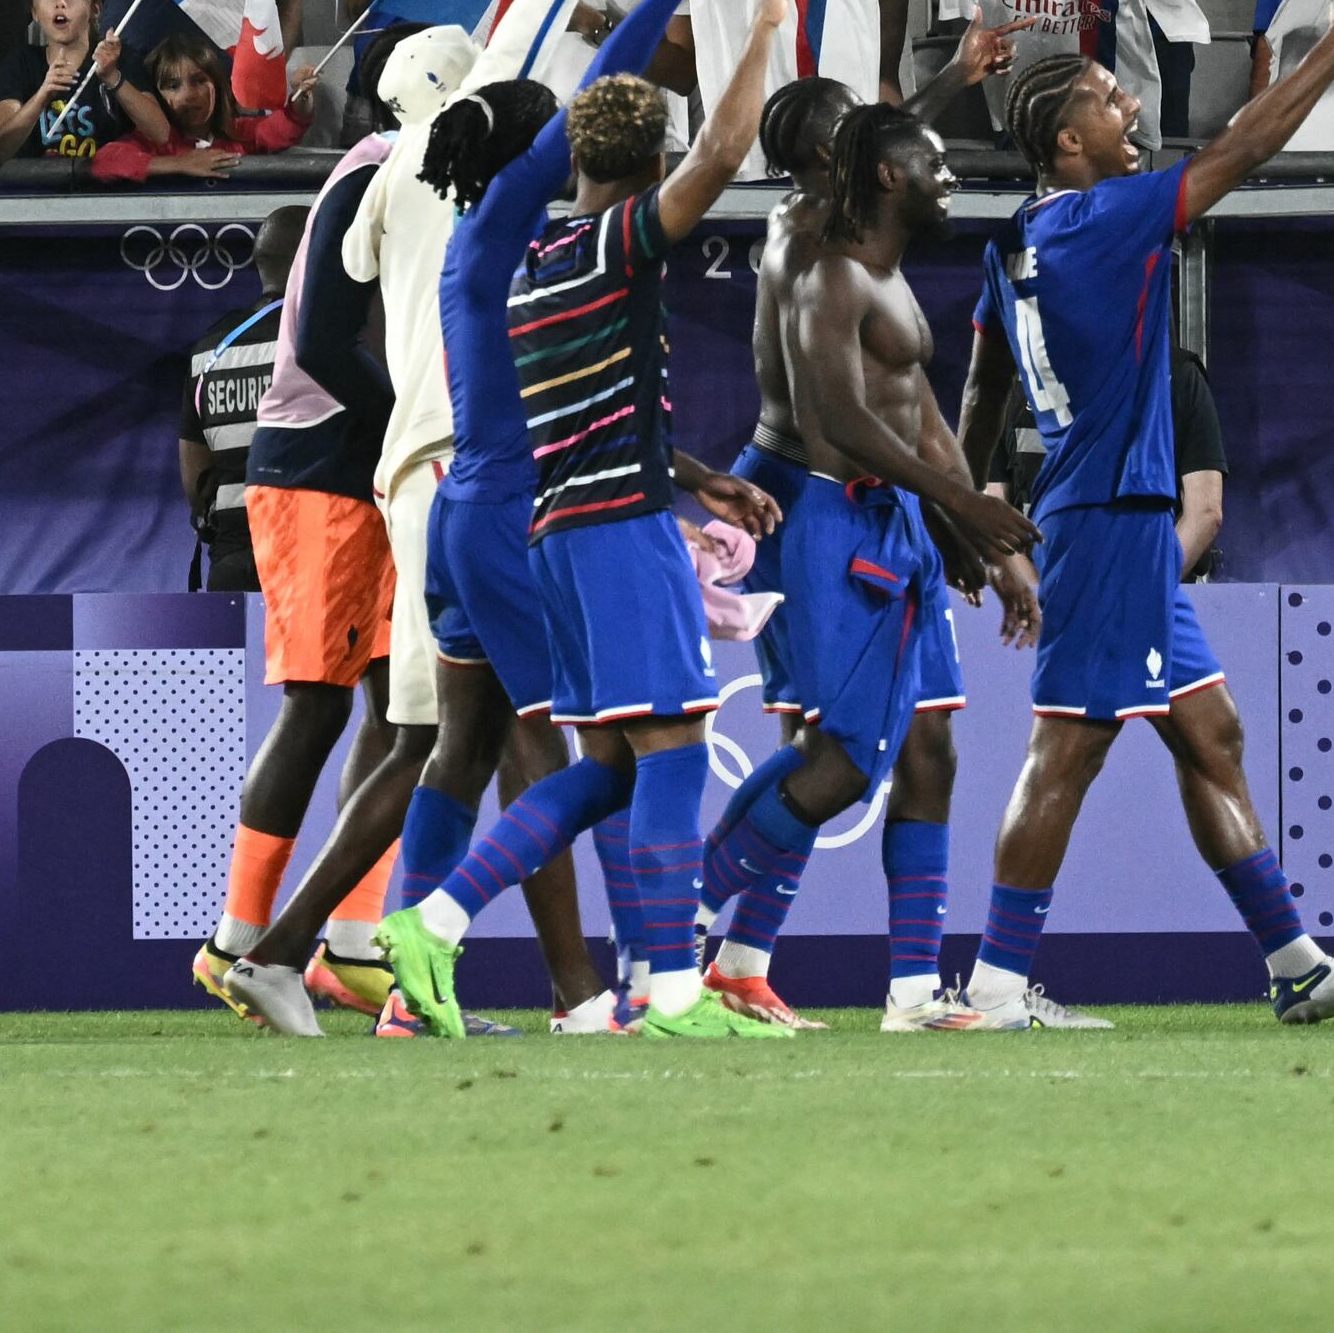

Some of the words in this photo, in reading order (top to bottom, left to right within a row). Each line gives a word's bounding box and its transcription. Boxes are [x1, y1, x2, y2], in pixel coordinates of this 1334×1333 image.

[1041, 16, 1097, 35] BETTER
[1015, 296, 1074, 428] 4
[208, 375, 272, 415] SECURIT
